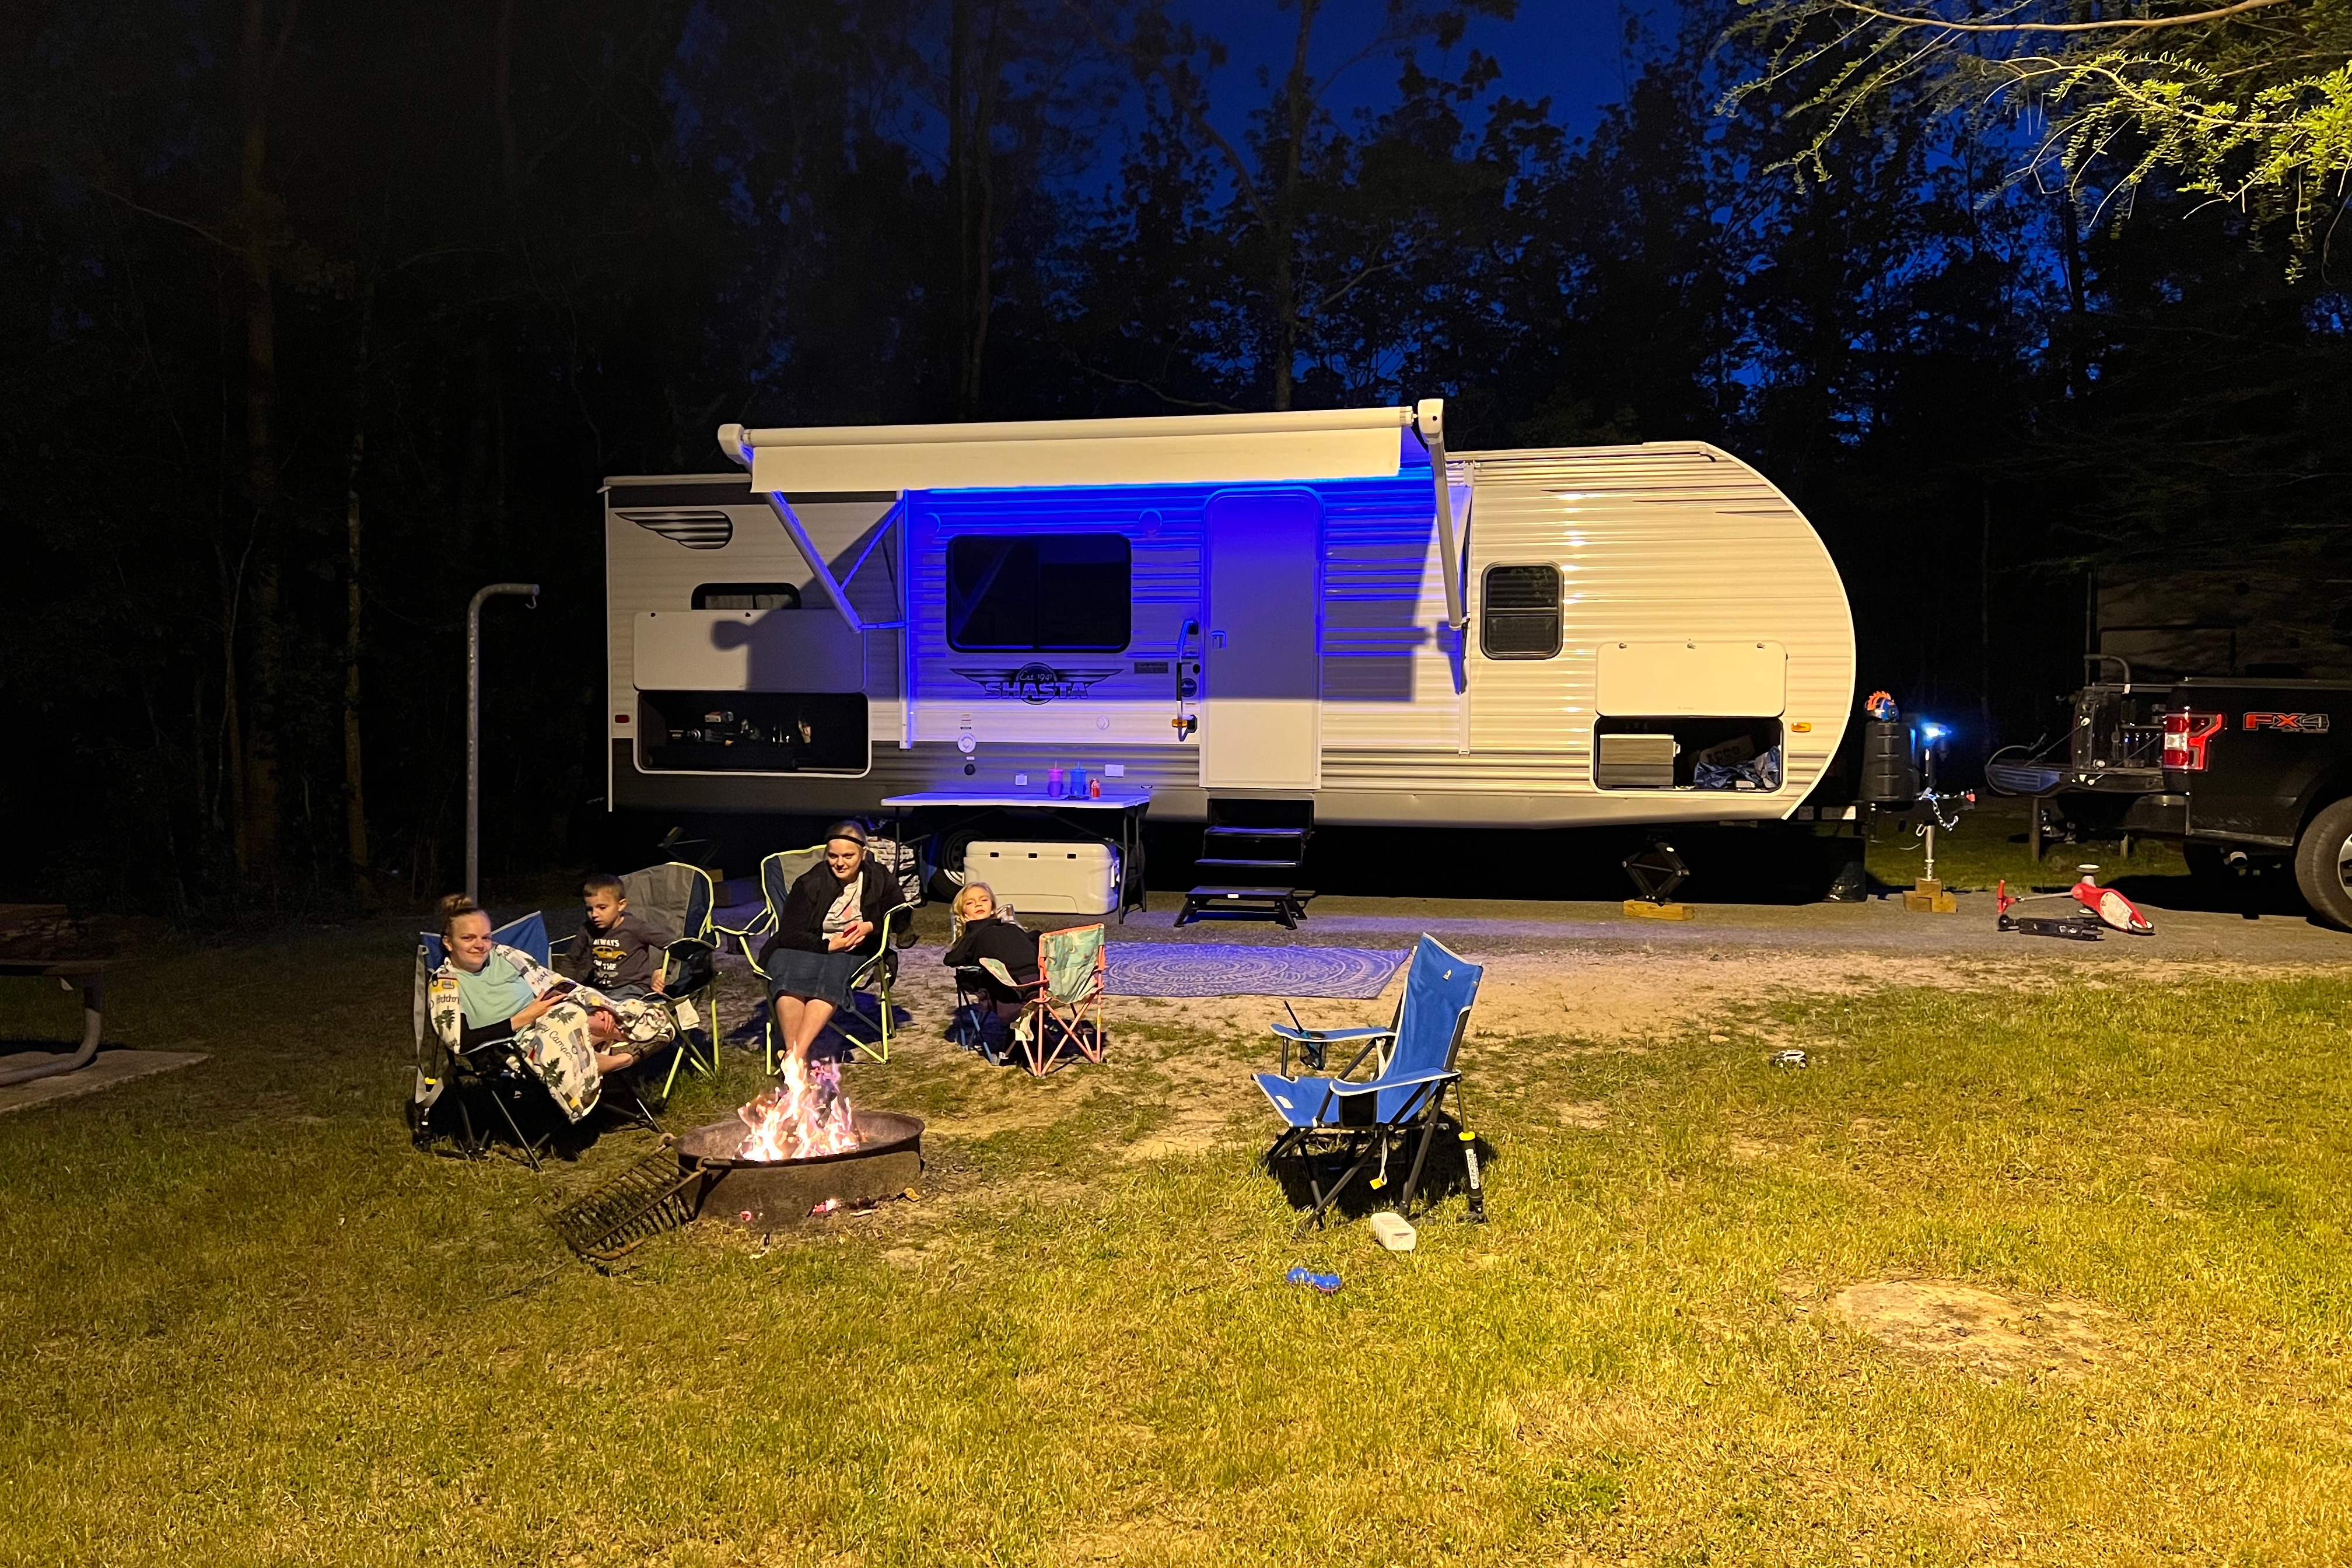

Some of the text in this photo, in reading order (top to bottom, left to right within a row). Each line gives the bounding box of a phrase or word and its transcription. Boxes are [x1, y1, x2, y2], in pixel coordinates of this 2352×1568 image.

[1037, 673, 1052, 681] 1941
[984, 681, 1089, 699] SHASTA
[2243, 712, 2330, 730] FX4
[549, 1030, 573, 1061] Camper
[1468, 1154, 1477, 1184] ROCKER
